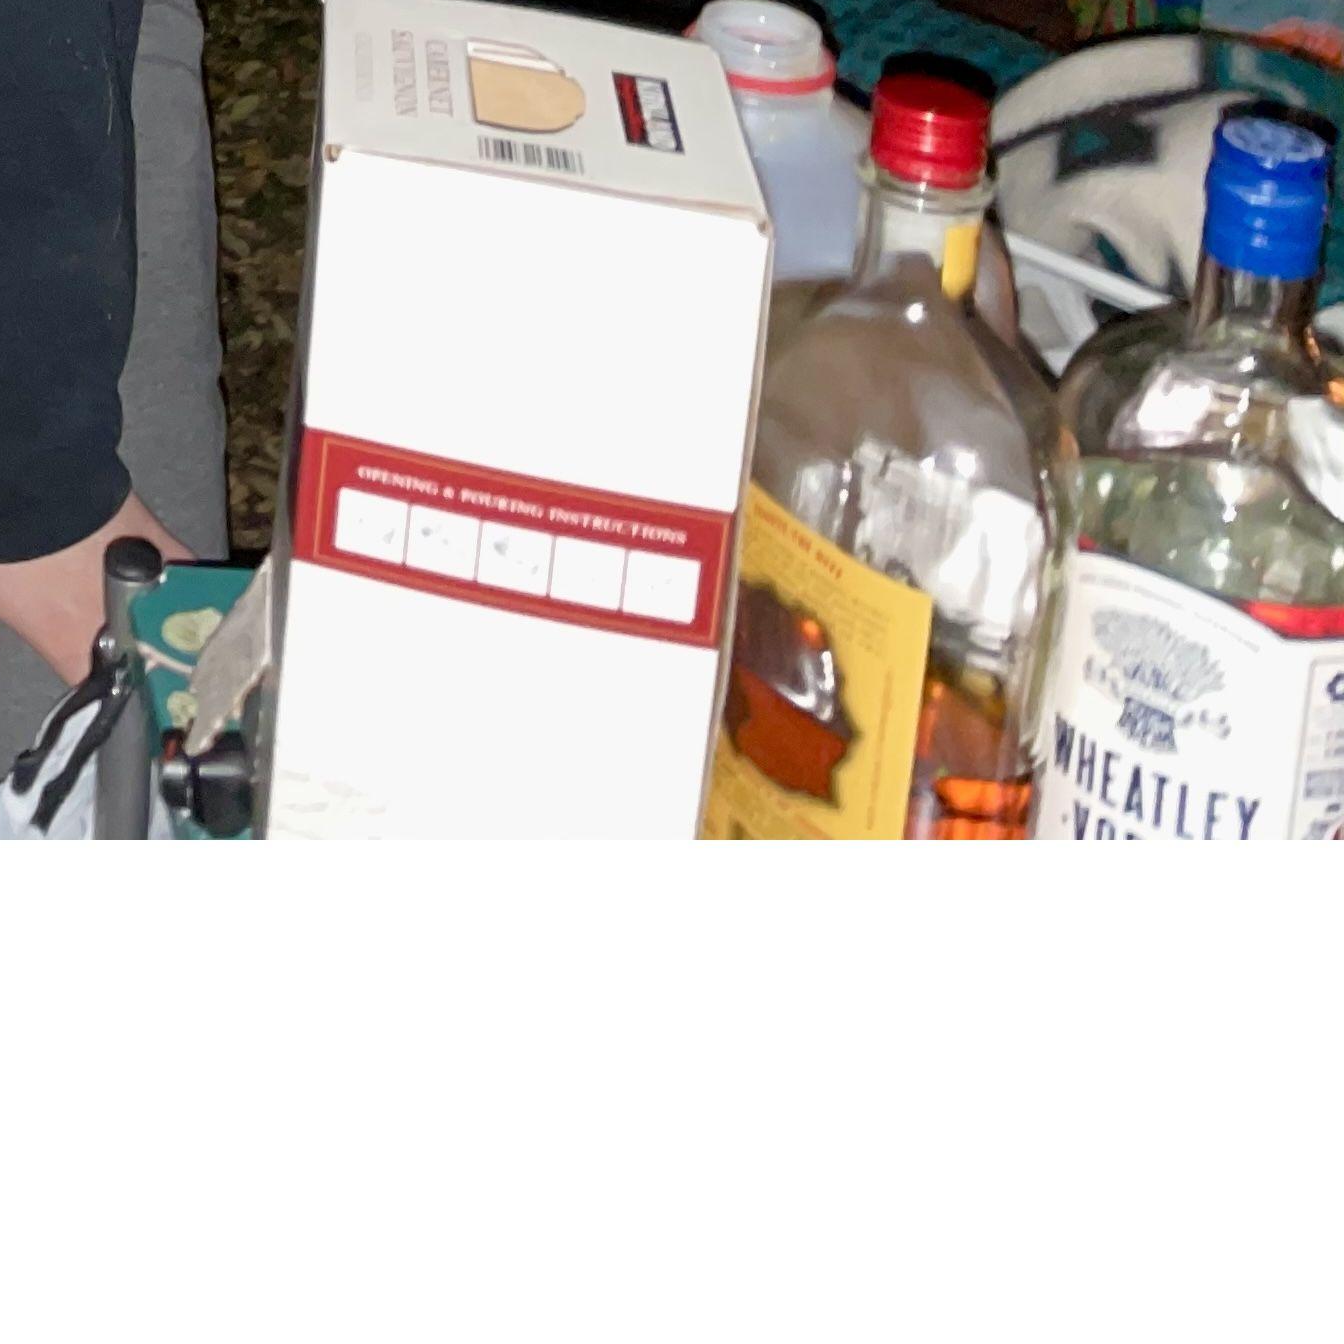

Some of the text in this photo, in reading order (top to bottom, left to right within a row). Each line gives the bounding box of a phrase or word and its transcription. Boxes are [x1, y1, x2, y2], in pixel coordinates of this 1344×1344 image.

[357, 465, 440, 497] OPENING
[460, 487, 544, 520] POURING
[1054, 711, 1260, 841] WHEATLEY
